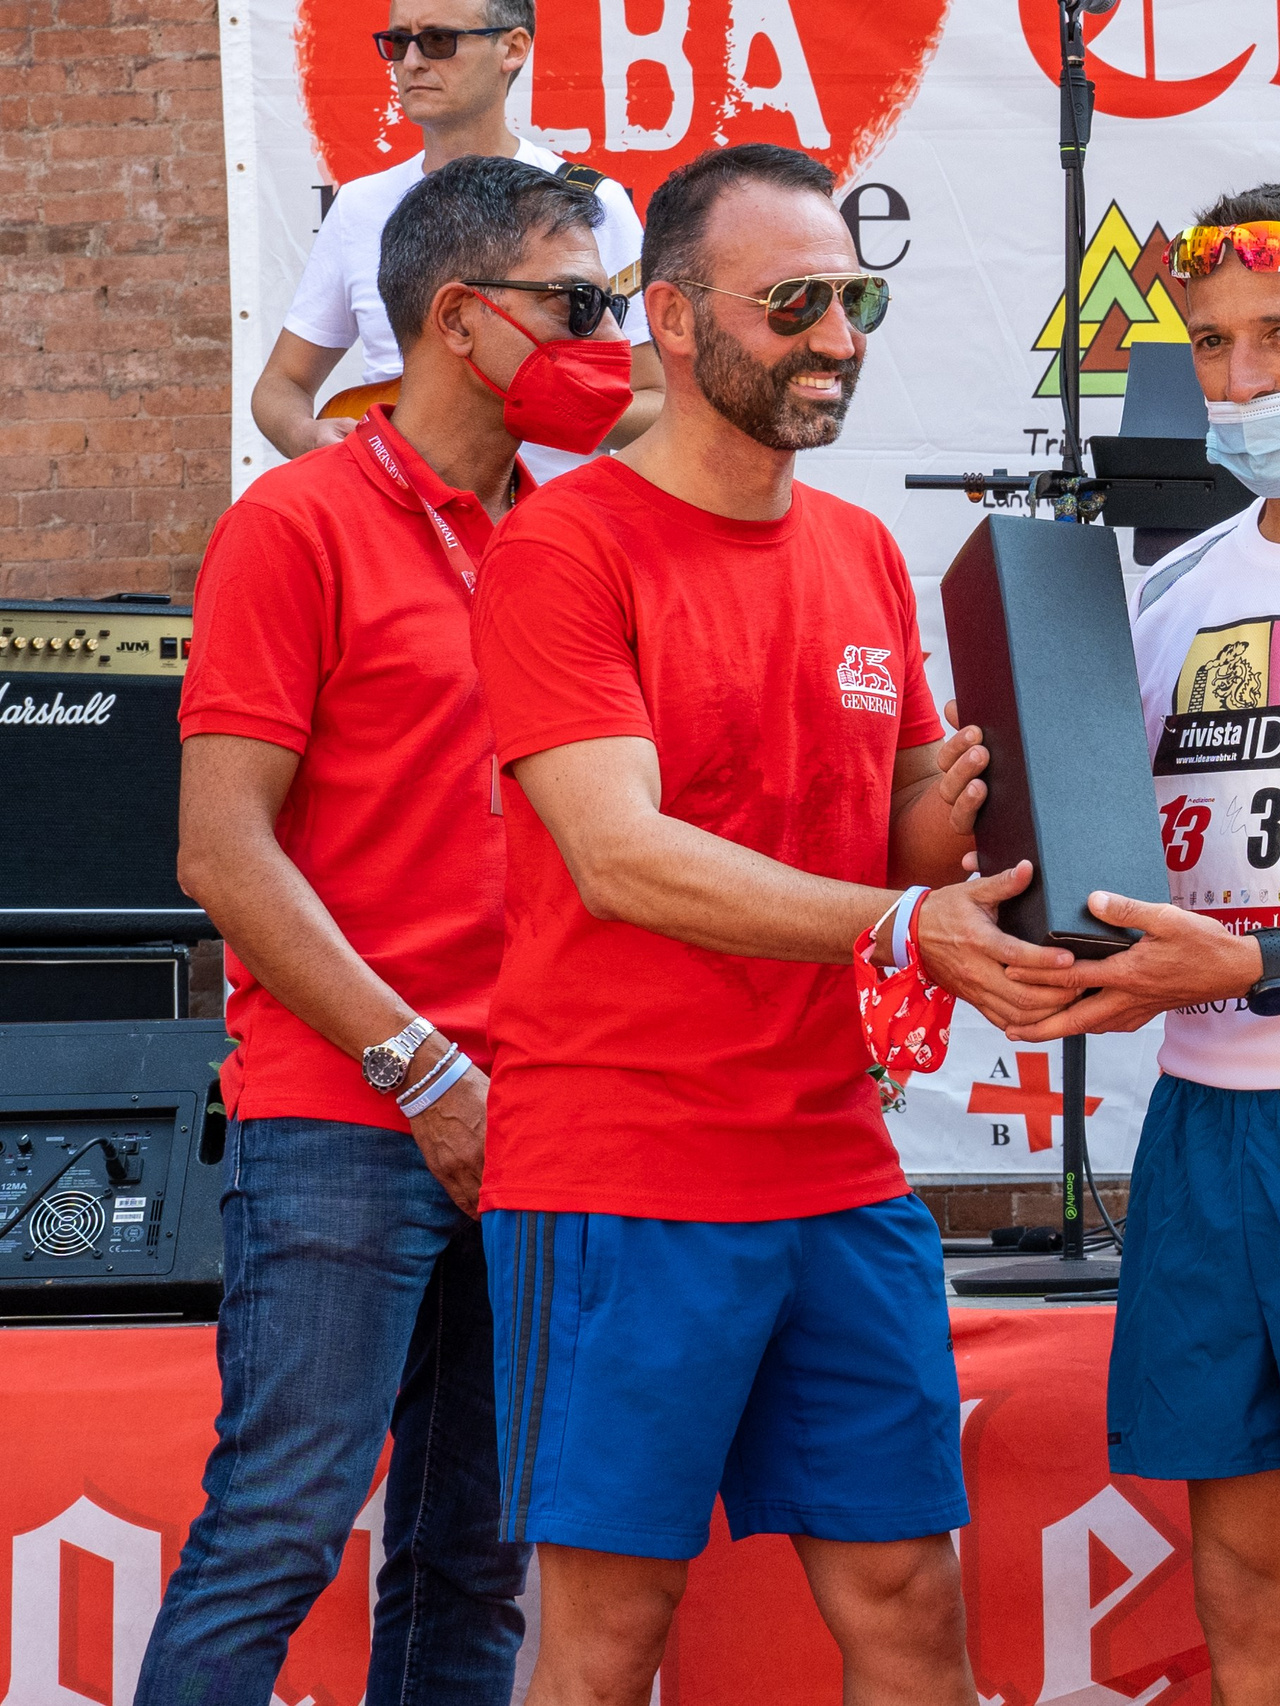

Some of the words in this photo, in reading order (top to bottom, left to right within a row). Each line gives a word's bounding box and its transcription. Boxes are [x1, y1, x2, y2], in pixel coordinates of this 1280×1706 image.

[375, 0, 831, 154] LBA
[368, 435, 400, 479] GENERALI
[116, 642, 149, 651] JVM
[841, 693, 897, 717] GENERALI
[1179, 721, 1242, 748] rivista
[1159, 794, 1212, 872] 13
[1065, 1172, 1076, 1205] Gravity
